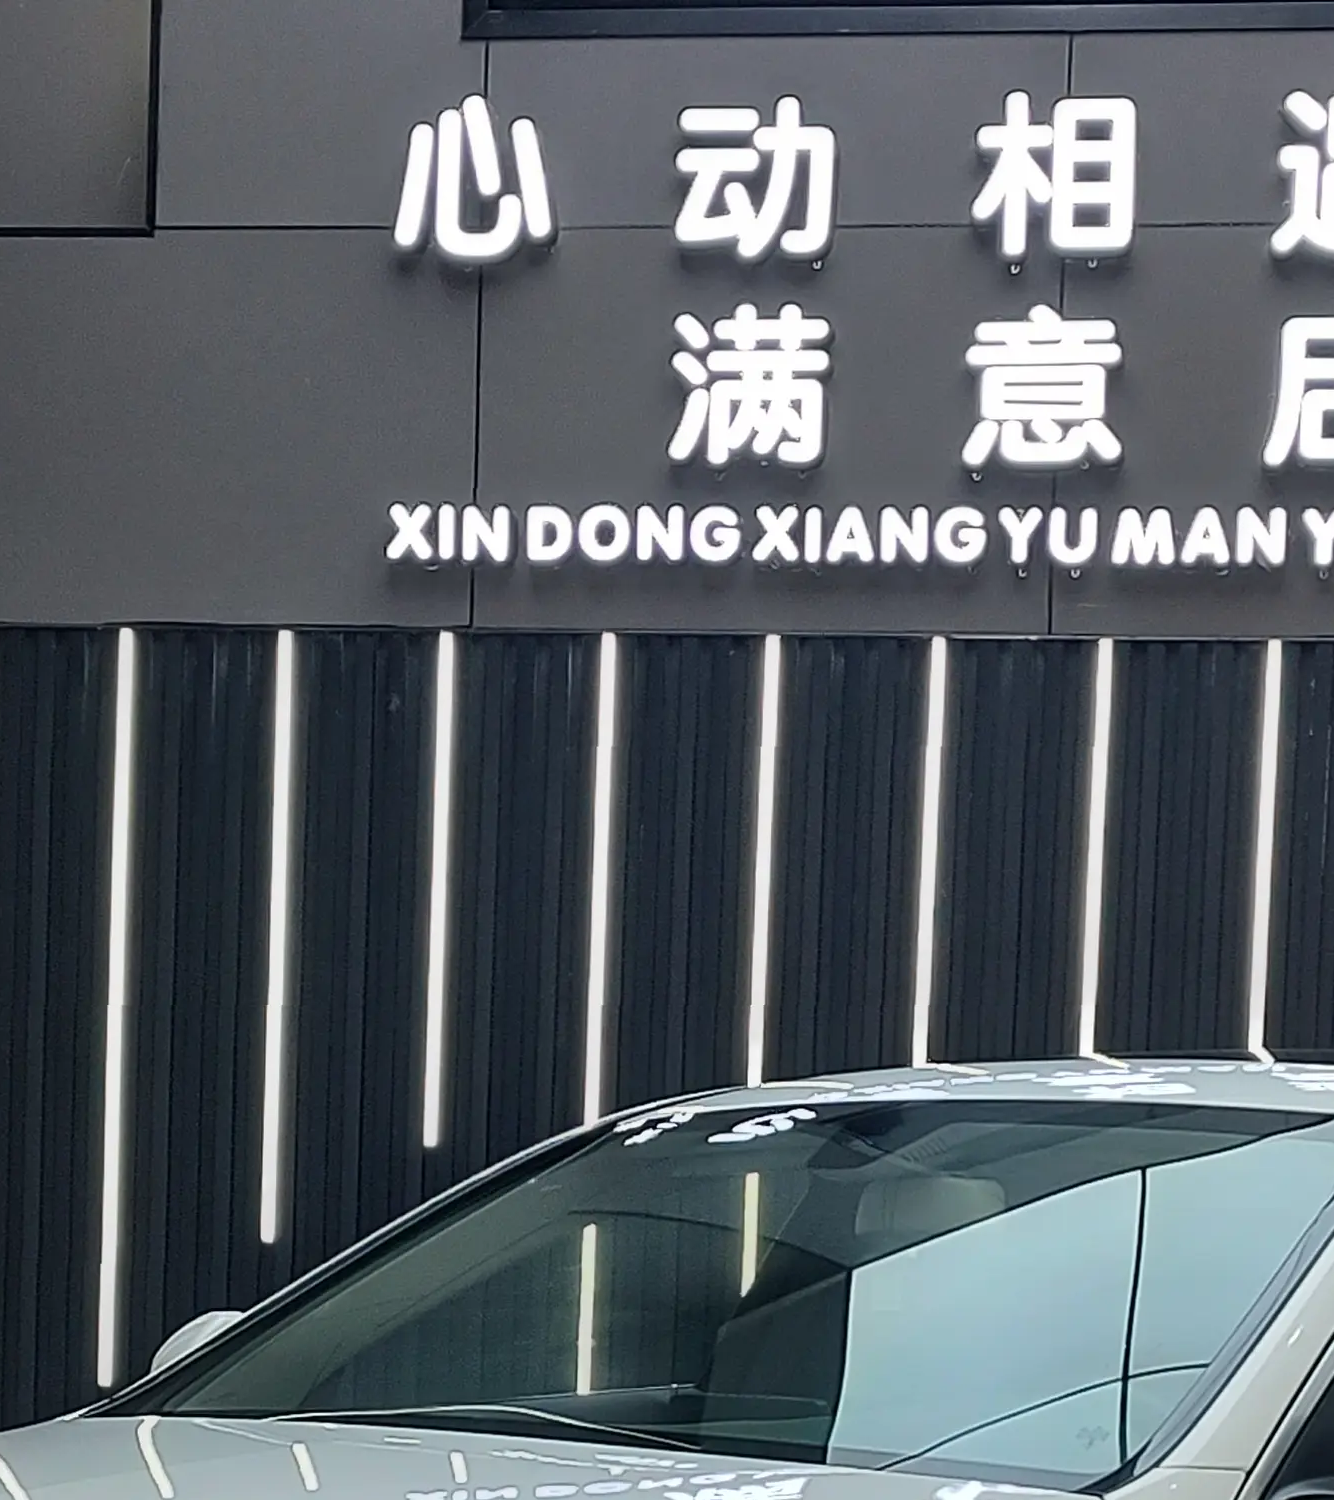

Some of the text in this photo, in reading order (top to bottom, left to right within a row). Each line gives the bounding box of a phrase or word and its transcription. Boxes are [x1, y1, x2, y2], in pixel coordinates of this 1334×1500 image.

[385, 503, 510, 563] XIN
[526, 504, 741, 563] DONG
[751, 505, 987, 564] XIANG
[998, 506, 1098, 565] YU
[1111, 507, 1287, 566] MAN
